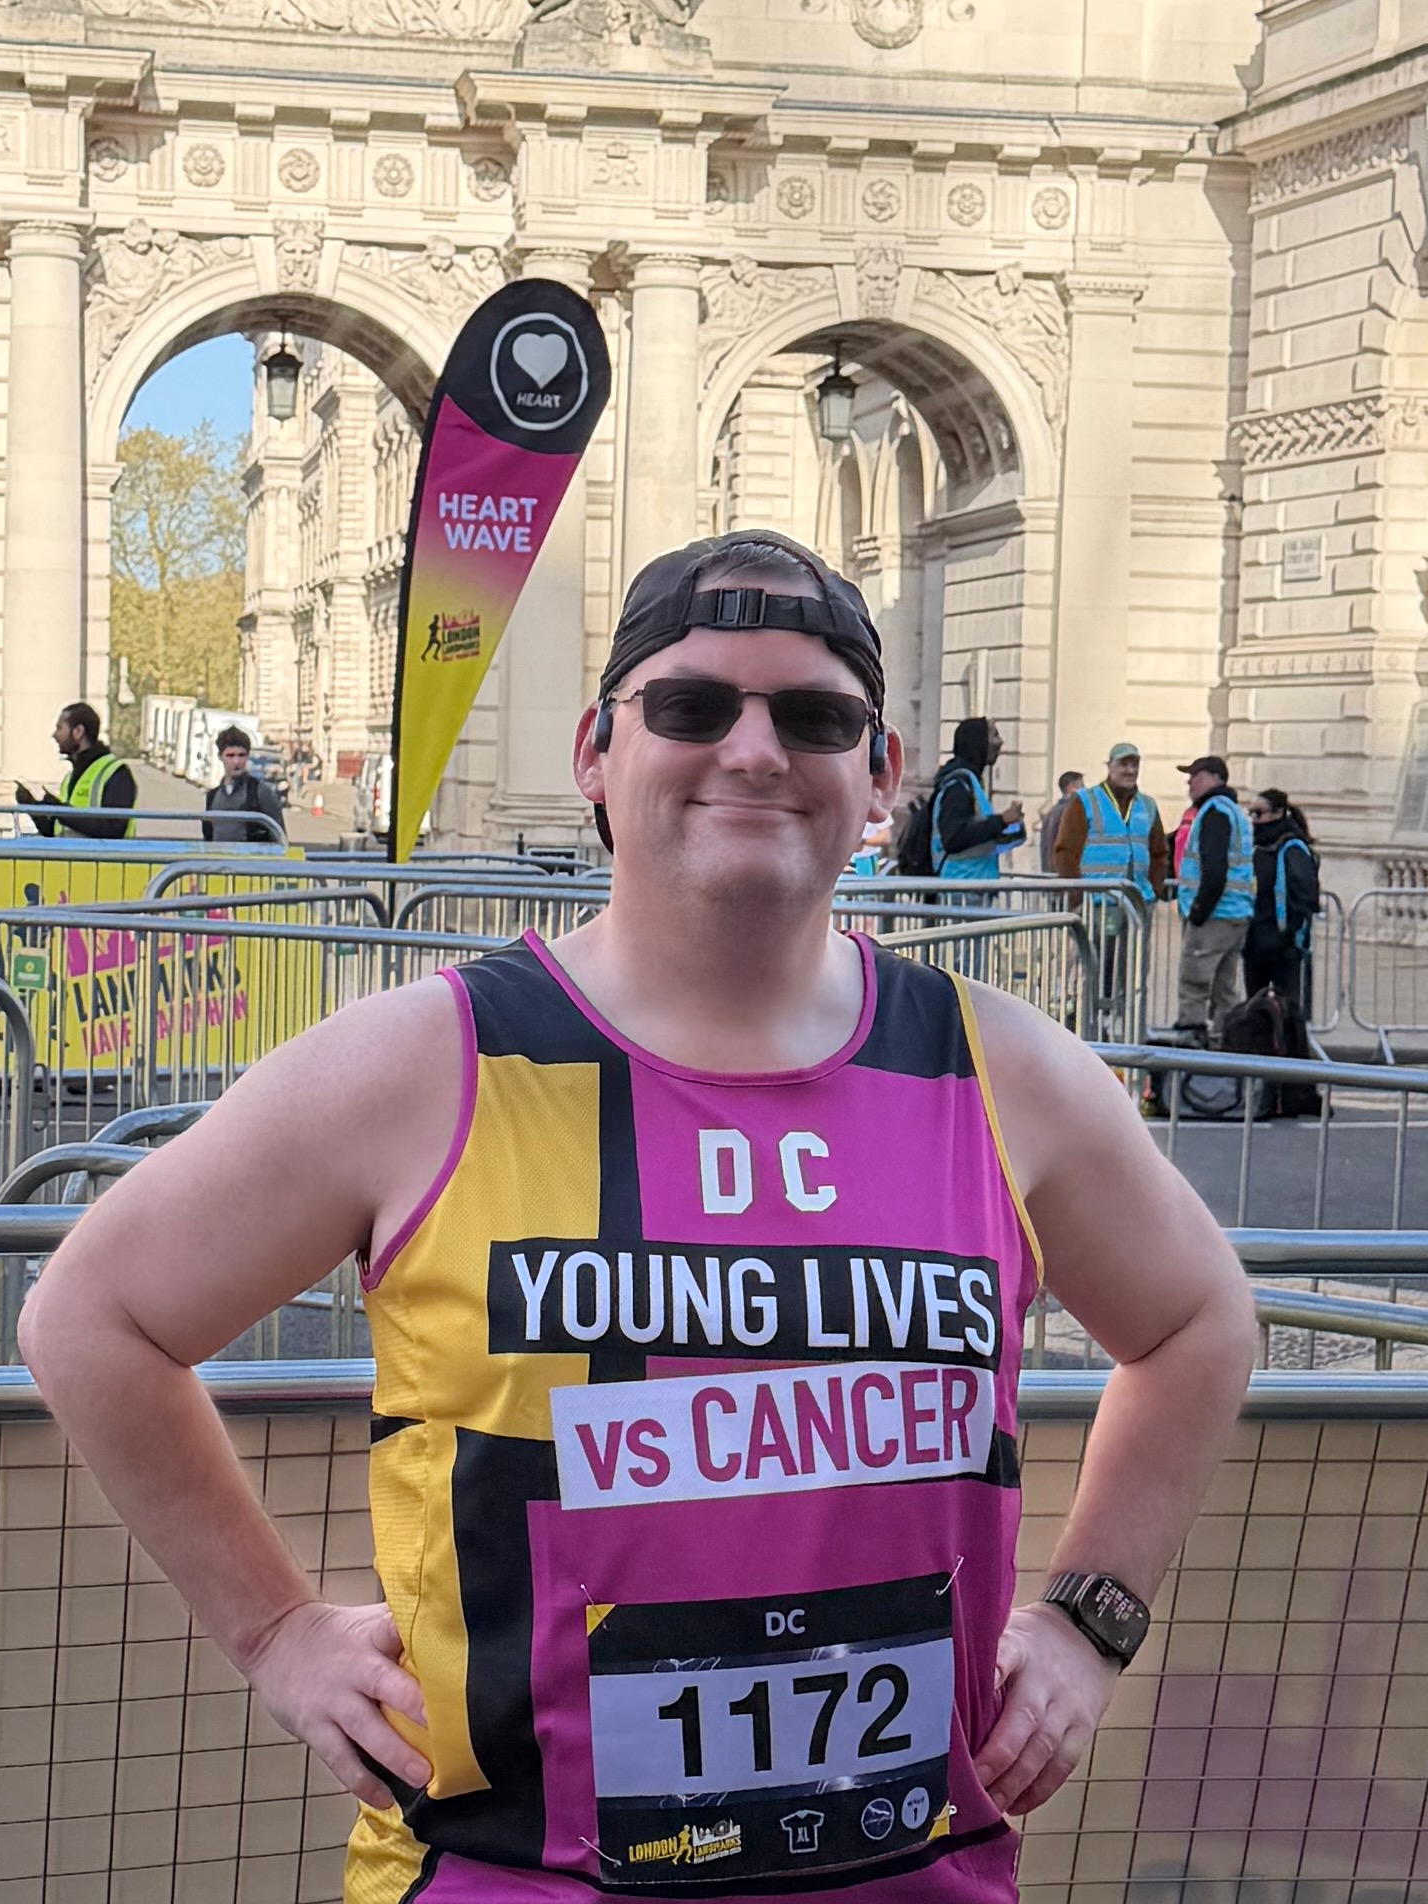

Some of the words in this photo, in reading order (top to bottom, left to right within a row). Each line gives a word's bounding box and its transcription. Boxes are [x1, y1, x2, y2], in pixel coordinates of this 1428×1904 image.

[516, 392, 562, 408] HEART
[438, 492, 538, 523] HEART
[444, 522, 532, 553] WAVE
[511, 1250, 778, 1348] YOUNG
[803, 1257, 996, 1358] LIVES
[690, 1367, 979, 1484] CANCER
[765, 1608, 807, 1637] DC
[658, 1663, 912, 1777] 1172
[628, 1835, 678, 1863] LONDON
